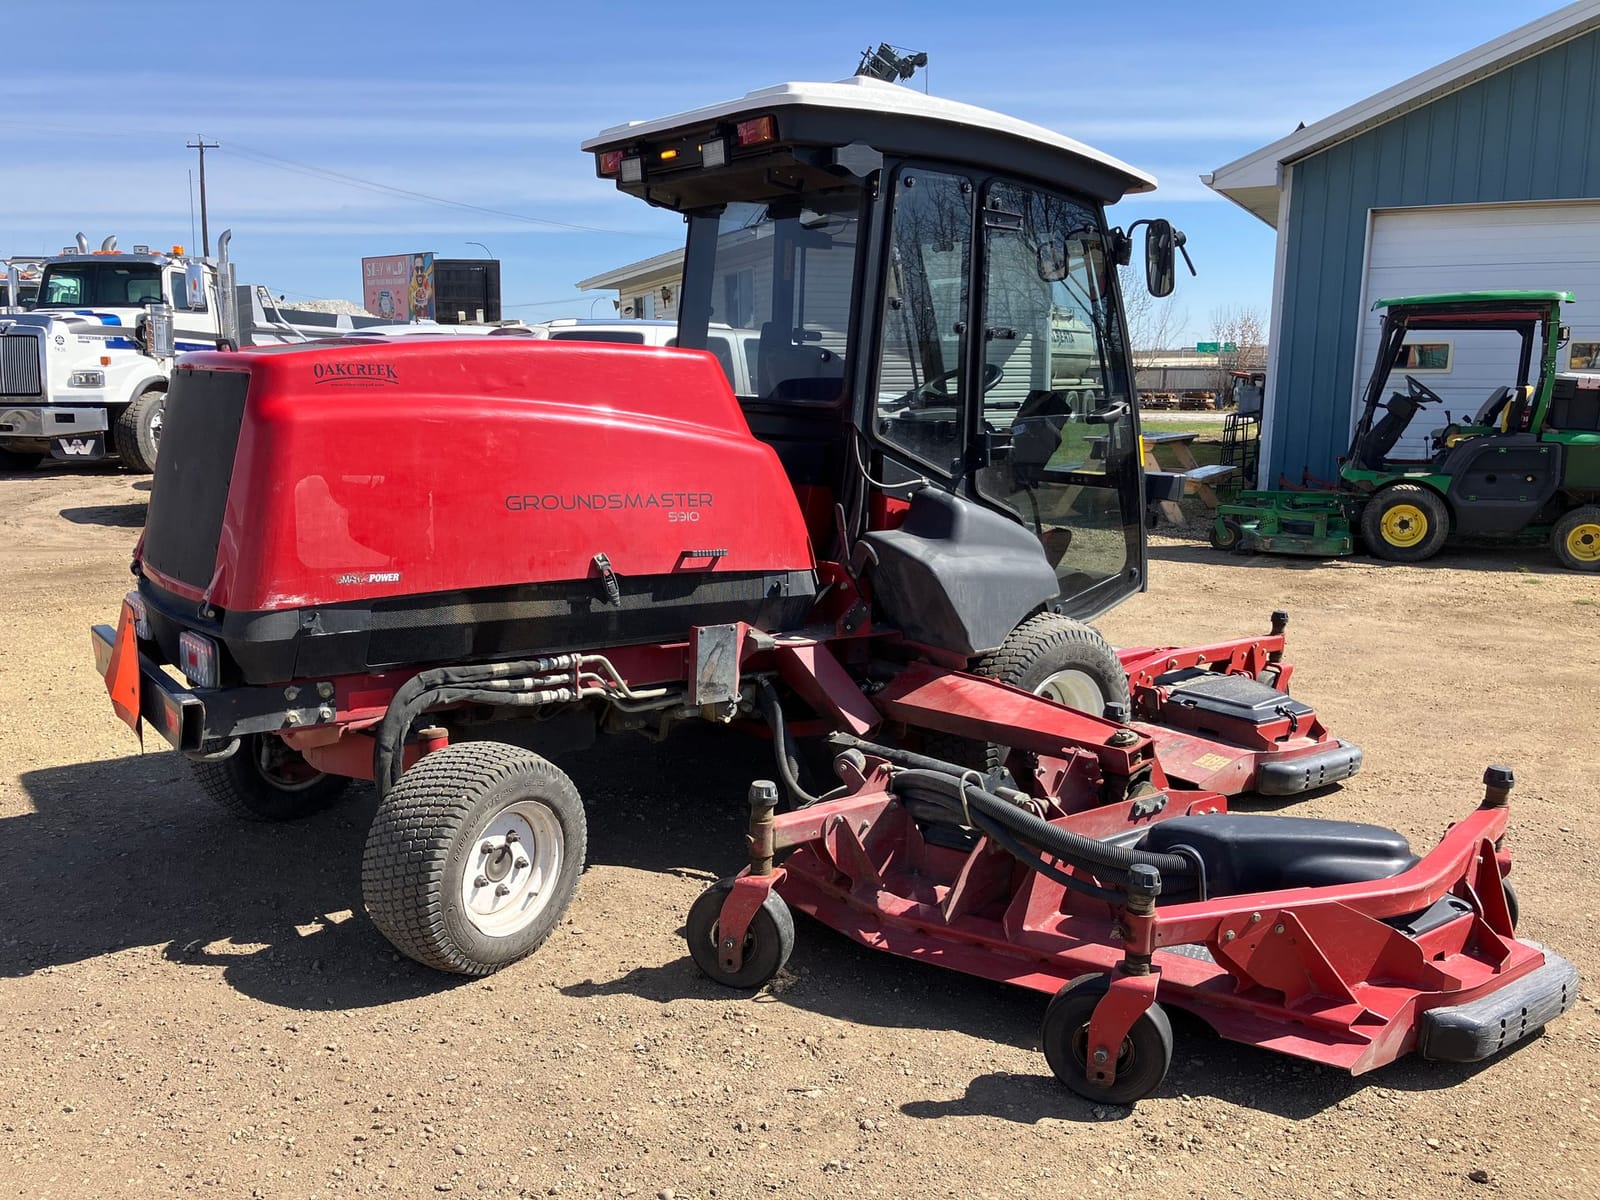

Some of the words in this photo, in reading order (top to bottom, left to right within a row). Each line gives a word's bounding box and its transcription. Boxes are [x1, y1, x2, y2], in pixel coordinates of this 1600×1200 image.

[313, 363, 399, 379] OAKCREEK
[505, 493, 713, 511] GROUNDSMASTER
[667, 511, 700, 522] 5910
[368, 573, 400, 583] POWER
